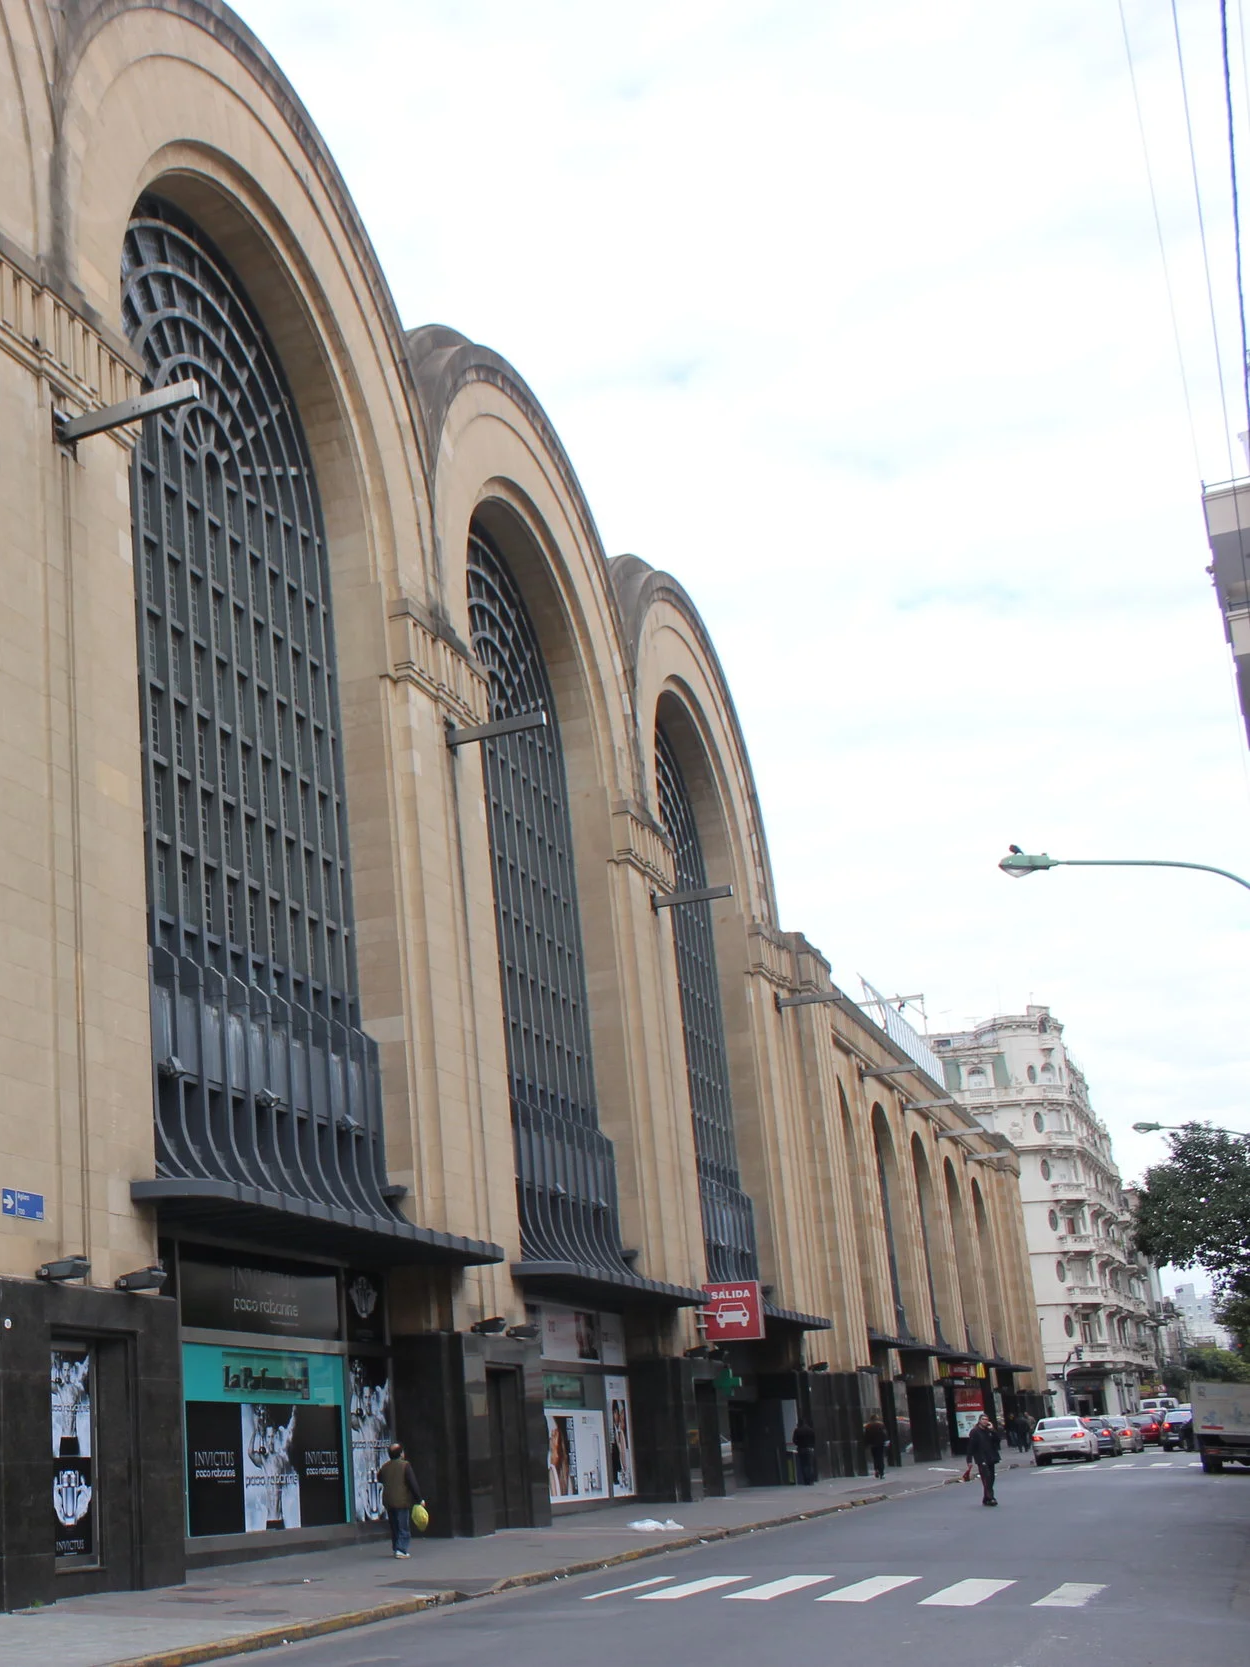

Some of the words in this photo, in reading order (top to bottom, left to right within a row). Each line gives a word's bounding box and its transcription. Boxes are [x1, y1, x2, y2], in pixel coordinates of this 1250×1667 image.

[711, 1289, 751, 1300] SALIDA
[233, 1298, 259, 1313] paco
[259, 1299, 299, 1317] rabanne
[194, 1451, 235, 1467] INVICTUS
[305, 1451, 338, 1465] INVICTUS
[195, 1468, 211, 1479] paco
[211, 1467, 236, 1478] rabanne
[306, 1467, 319, 1476] paco
[319, 1466, 339, 1475] rabanne
[245, 1475, 265, 1487] paco
[56, 1539, 85, 1551] INVICTUS
